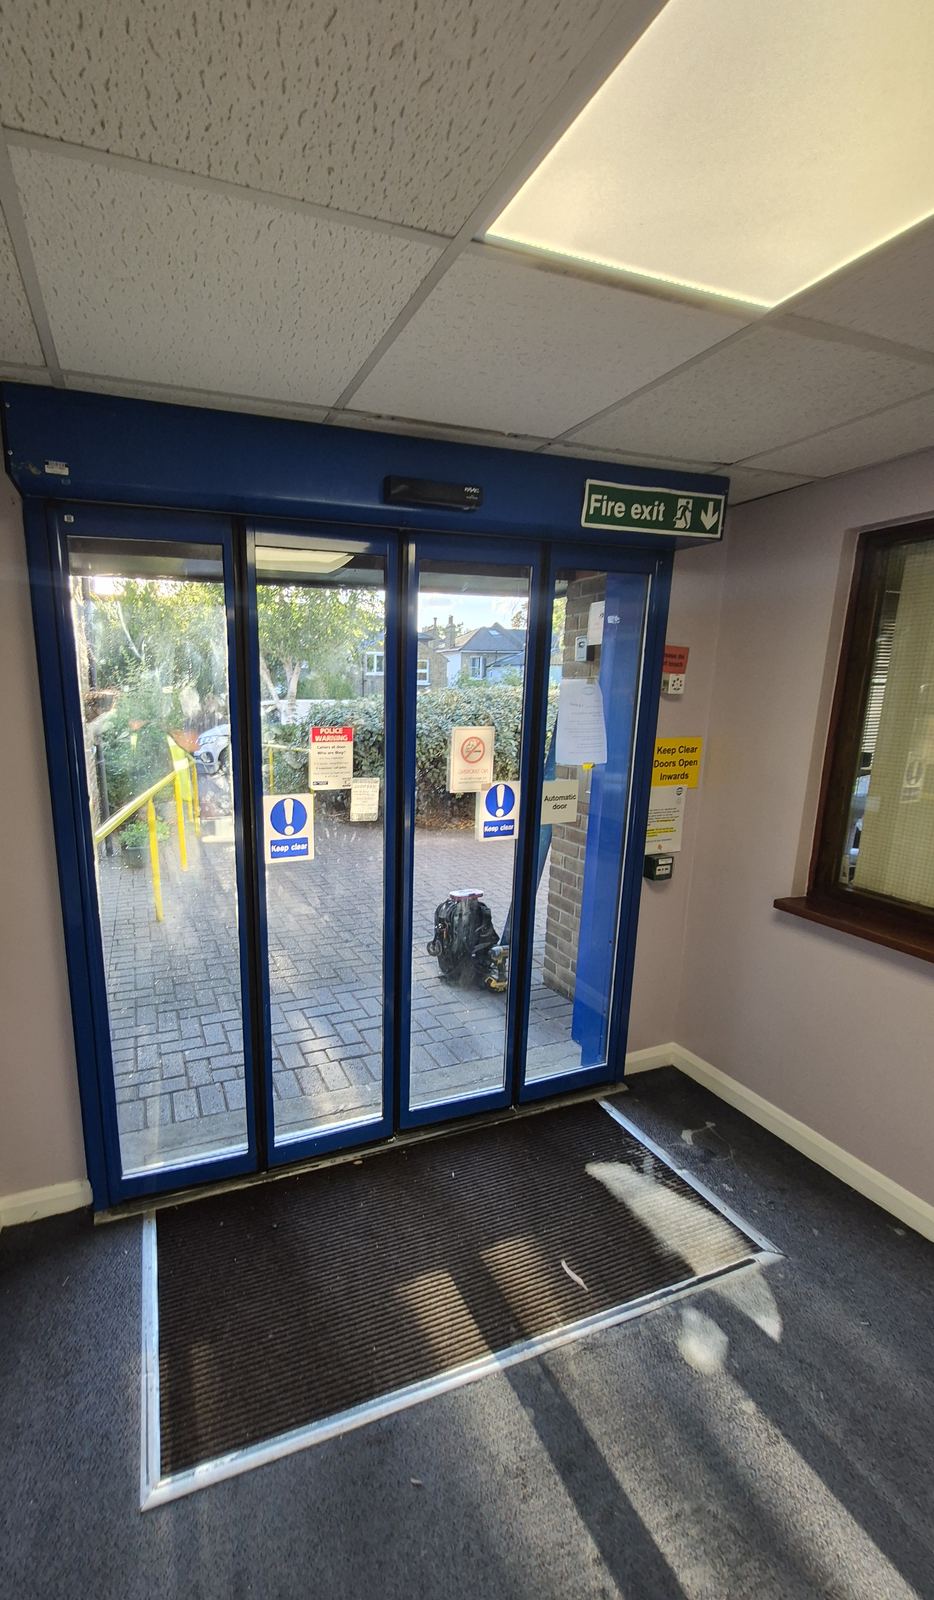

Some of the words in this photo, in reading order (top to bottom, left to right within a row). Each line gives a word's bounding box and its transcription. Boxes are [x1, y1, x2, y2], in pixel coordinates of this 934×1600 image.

[589, 494, 626, 518] Fire
[630, 501, 665, 521] exit
[319, 727, 343, 735] POLICE
[656, 746, 676, 756] Keep
[678, 745, 698, 754] Clear
[653, 760, 676, 768] Doors
[678, 758, 698, 768] Open
[660, 771, 689, 781] Inwards
[544, 794, 576, 802] Automatic
[271, 844, 289, 853] Keep
[290, 843, 308, 851] clear
